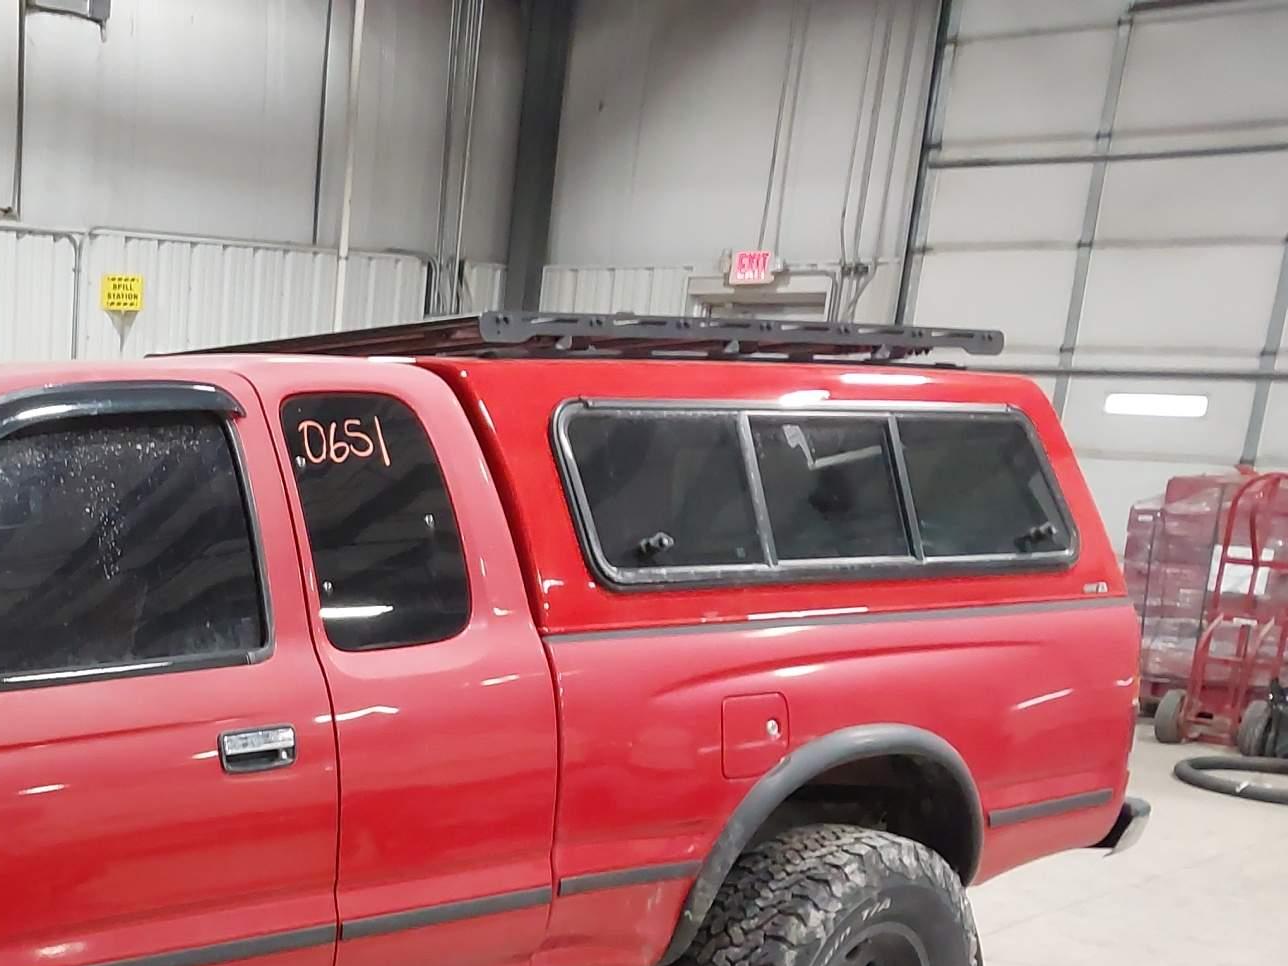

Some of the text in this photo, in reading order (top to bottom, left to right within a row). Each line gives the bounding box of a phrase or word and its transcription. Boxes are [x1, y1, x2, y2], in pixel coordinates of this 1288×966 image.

[737, 252, 770, 274] EXIT
[112, 283, 133, 292] SPILL
[107, 292, 139, 301] STATION
[297, 415, 392, 467] 0651
